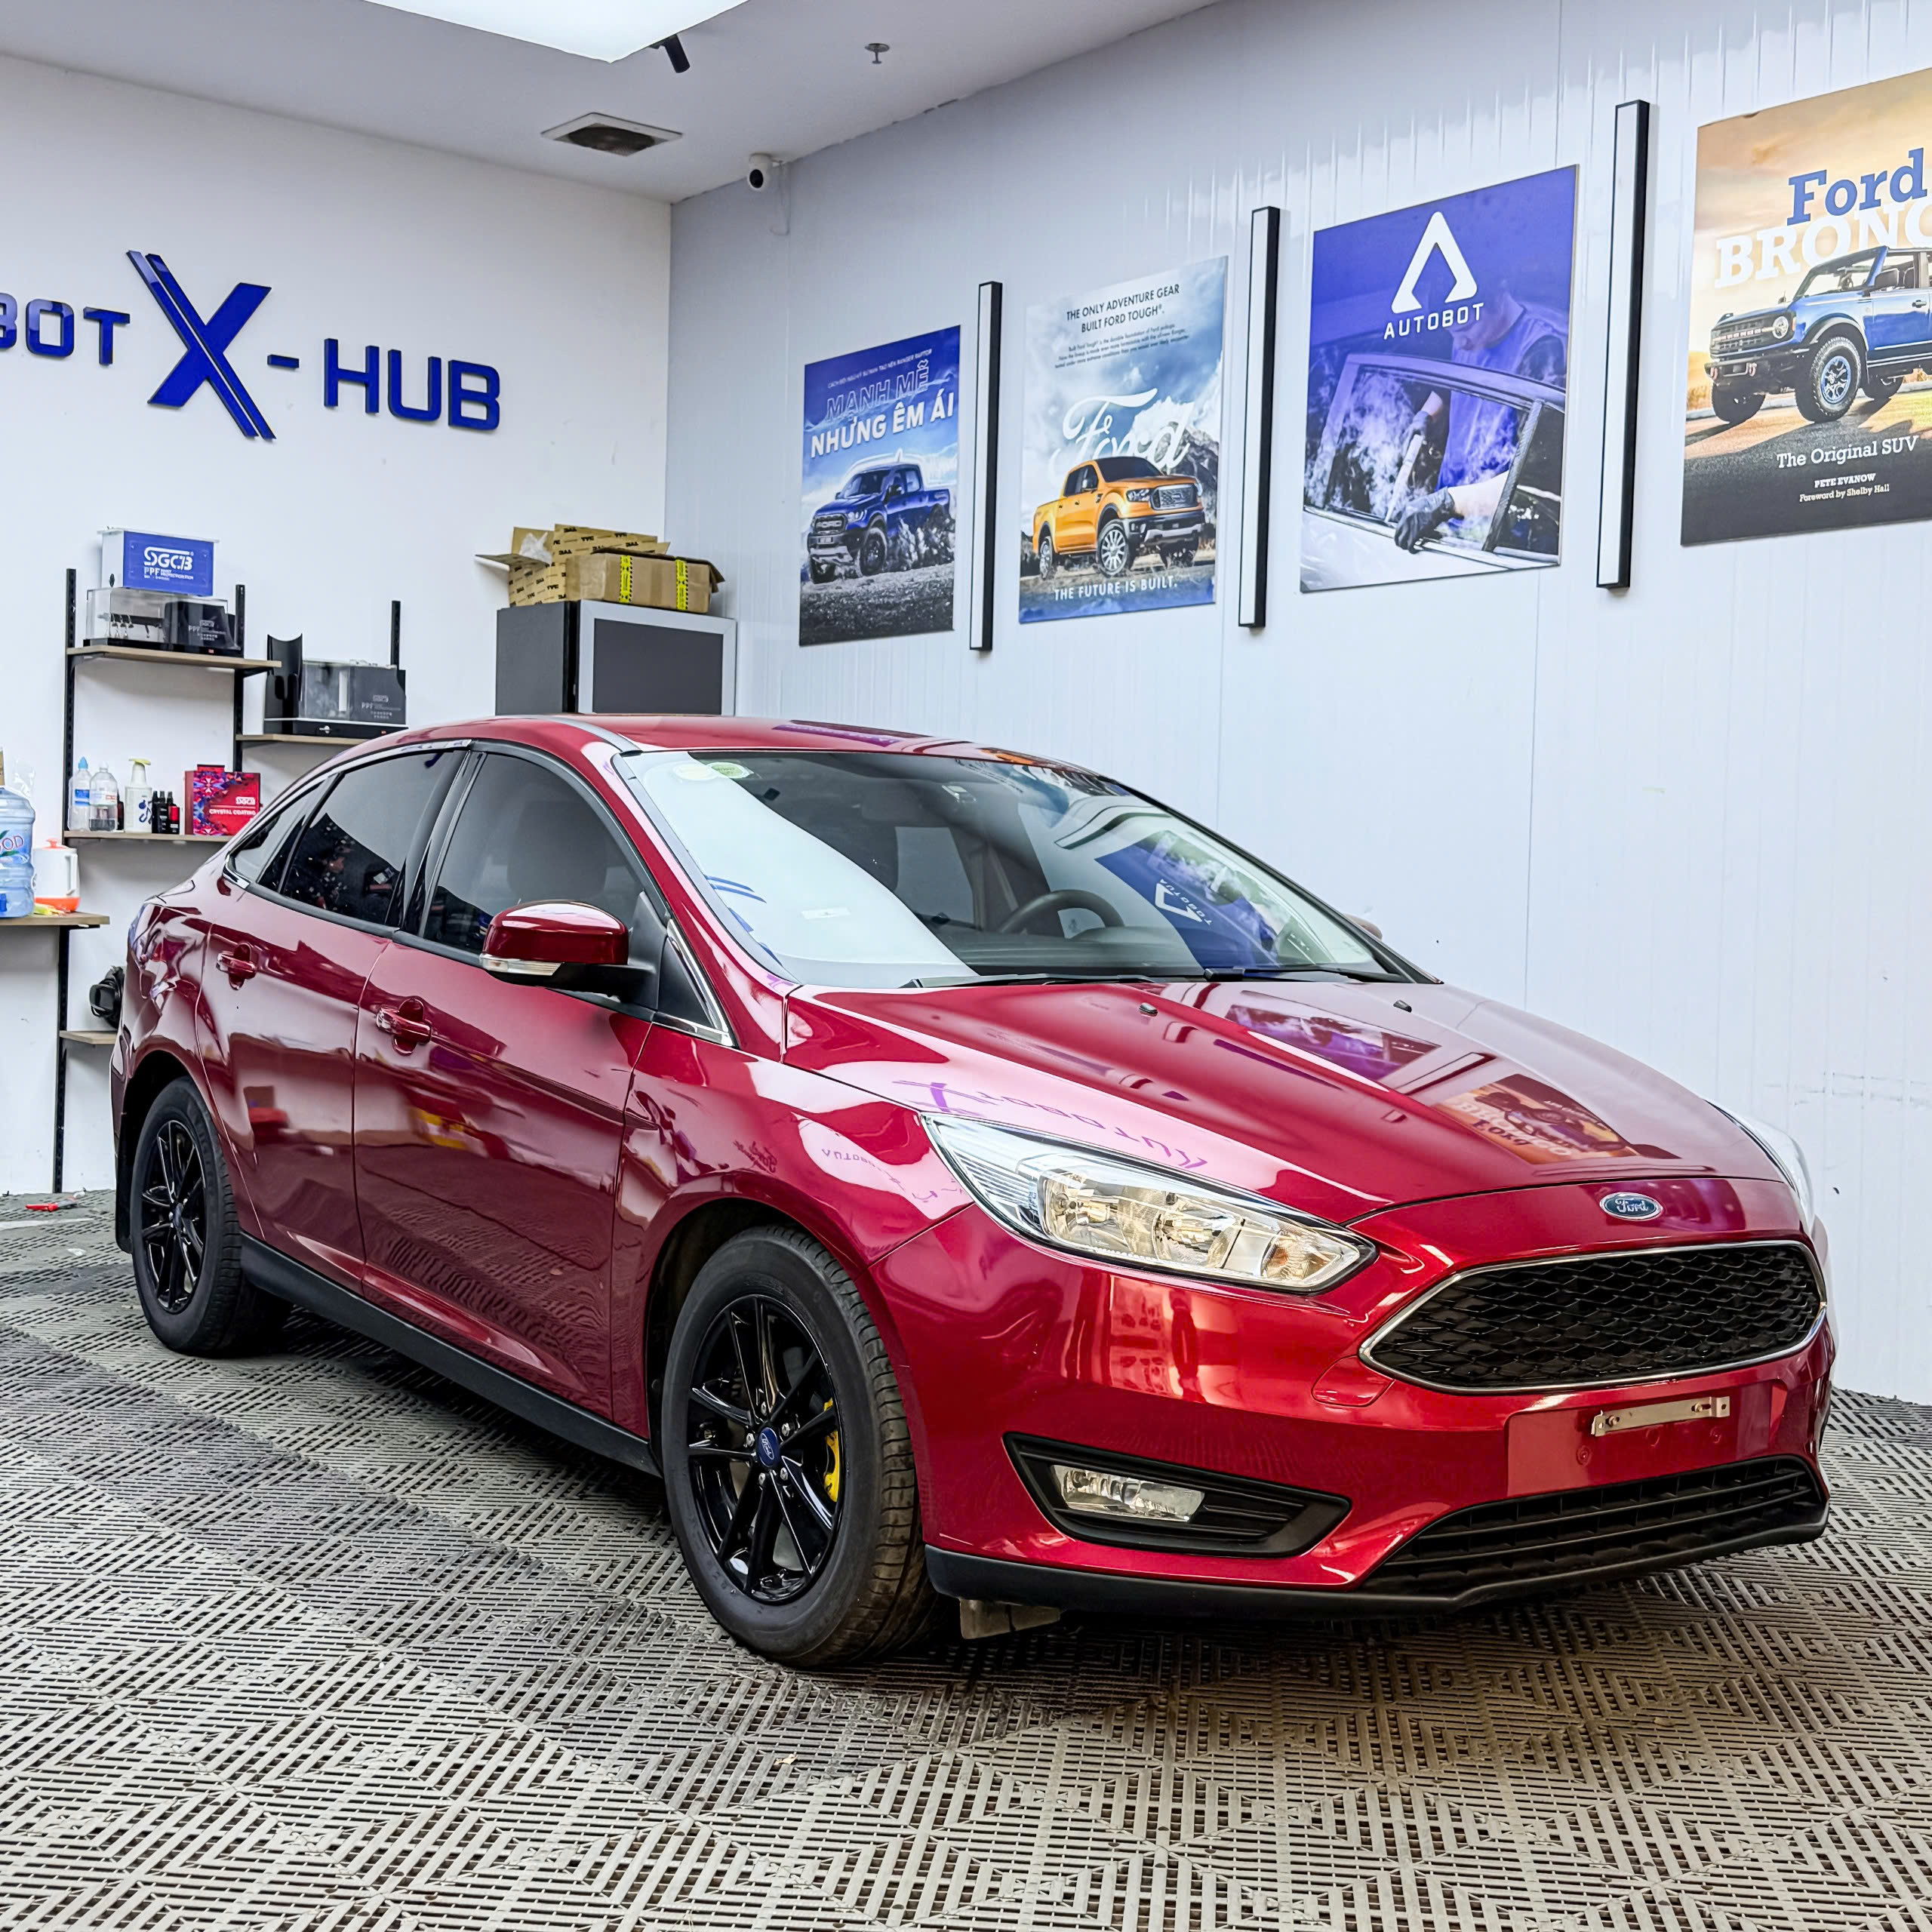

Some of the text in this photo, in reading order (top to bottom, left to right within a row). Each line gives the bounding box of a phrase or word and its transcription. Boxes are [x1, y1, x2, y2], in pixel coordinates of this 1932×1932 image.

[1786, 147, 1927, 226] Ford
[1066, 284, 1180, 321] THE ONLY ADVENTURE GEAR
[1081, 318, 1102, 333] BUILT
[1104, 312, 1126, 328] FORD
[1384, 303, 1484, 340] AUTOBOT
[125, 250, 276, 440] X
[323, 337, 500, 431] HUB
[826, 379, 891, 421] MẠNH
[893, 401, 924, 434] ÊM
[930, 388, 955, 423] ÁI
[1777, 435, 1919, 469] The Original SUV
[1799, 484, 1890, 503] Foreword by Shelby Hall
[1814, 473, 1876, 488] PETE EVANOW
[144, 567, 160, 576] PPF
[1055, 587, 1074, 601] THE
[1078, 581, 1120, 598] FUTURE
[1125, 580, 1136, 593] IS
[1614, 1197, 1649, 1213] Ford
